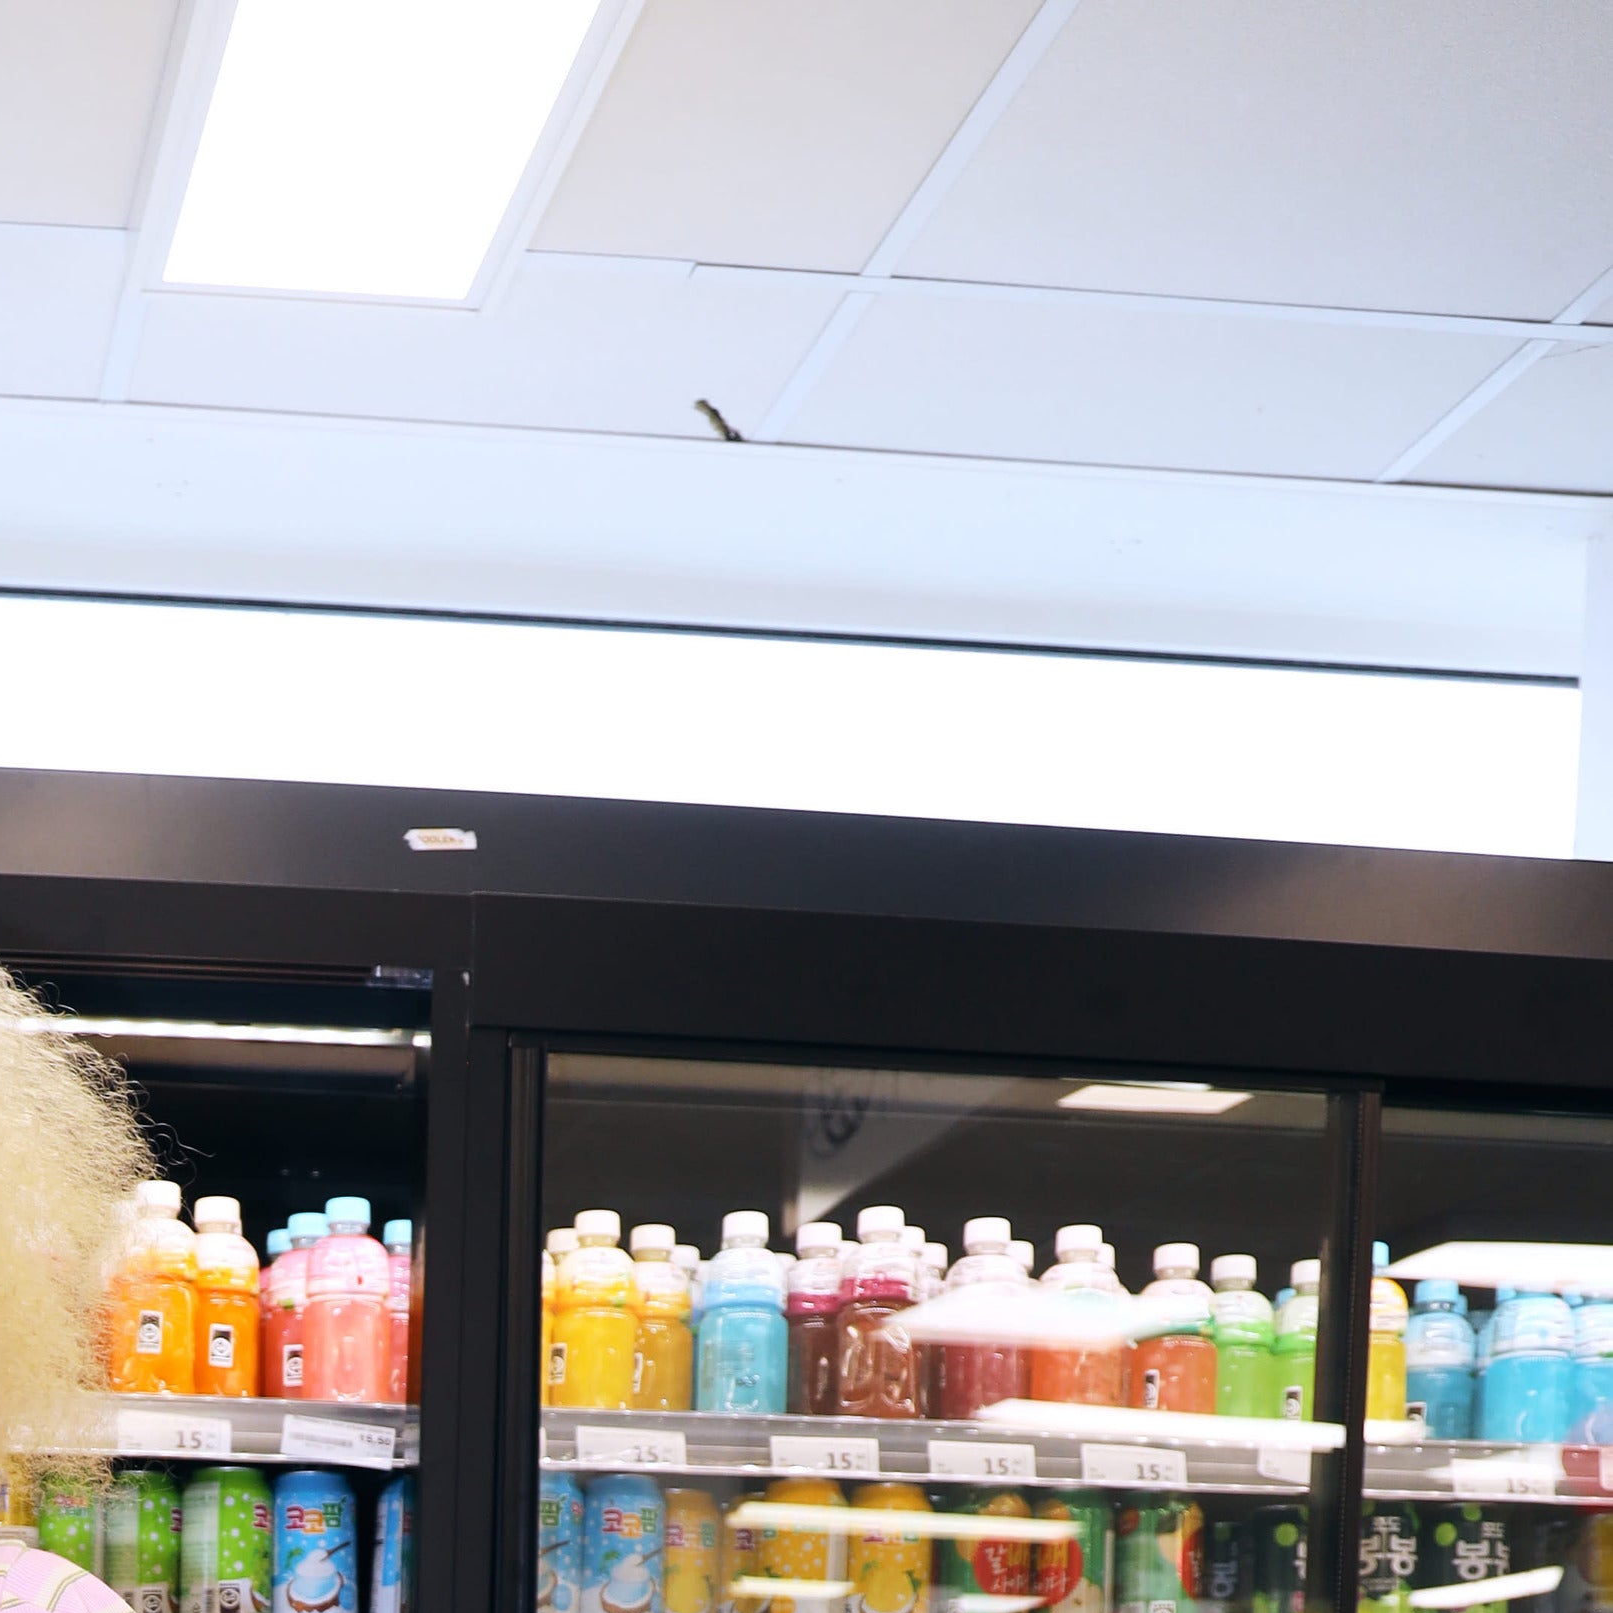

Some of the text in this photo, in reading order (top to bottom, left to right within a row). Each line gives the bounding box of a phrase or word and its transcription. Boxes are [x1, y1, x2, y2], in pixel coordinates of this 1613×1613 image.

[175, 1429, 202, 1450] 15
[827, 1452, 852, 1469] 15
[985, 1457, 1009, 1474] 15
[1136, 1463, 1160, 1480] 15
[284, 1501, 343, 1535] 코코팜
[601, 1506, 660, 1539] 코코팜
